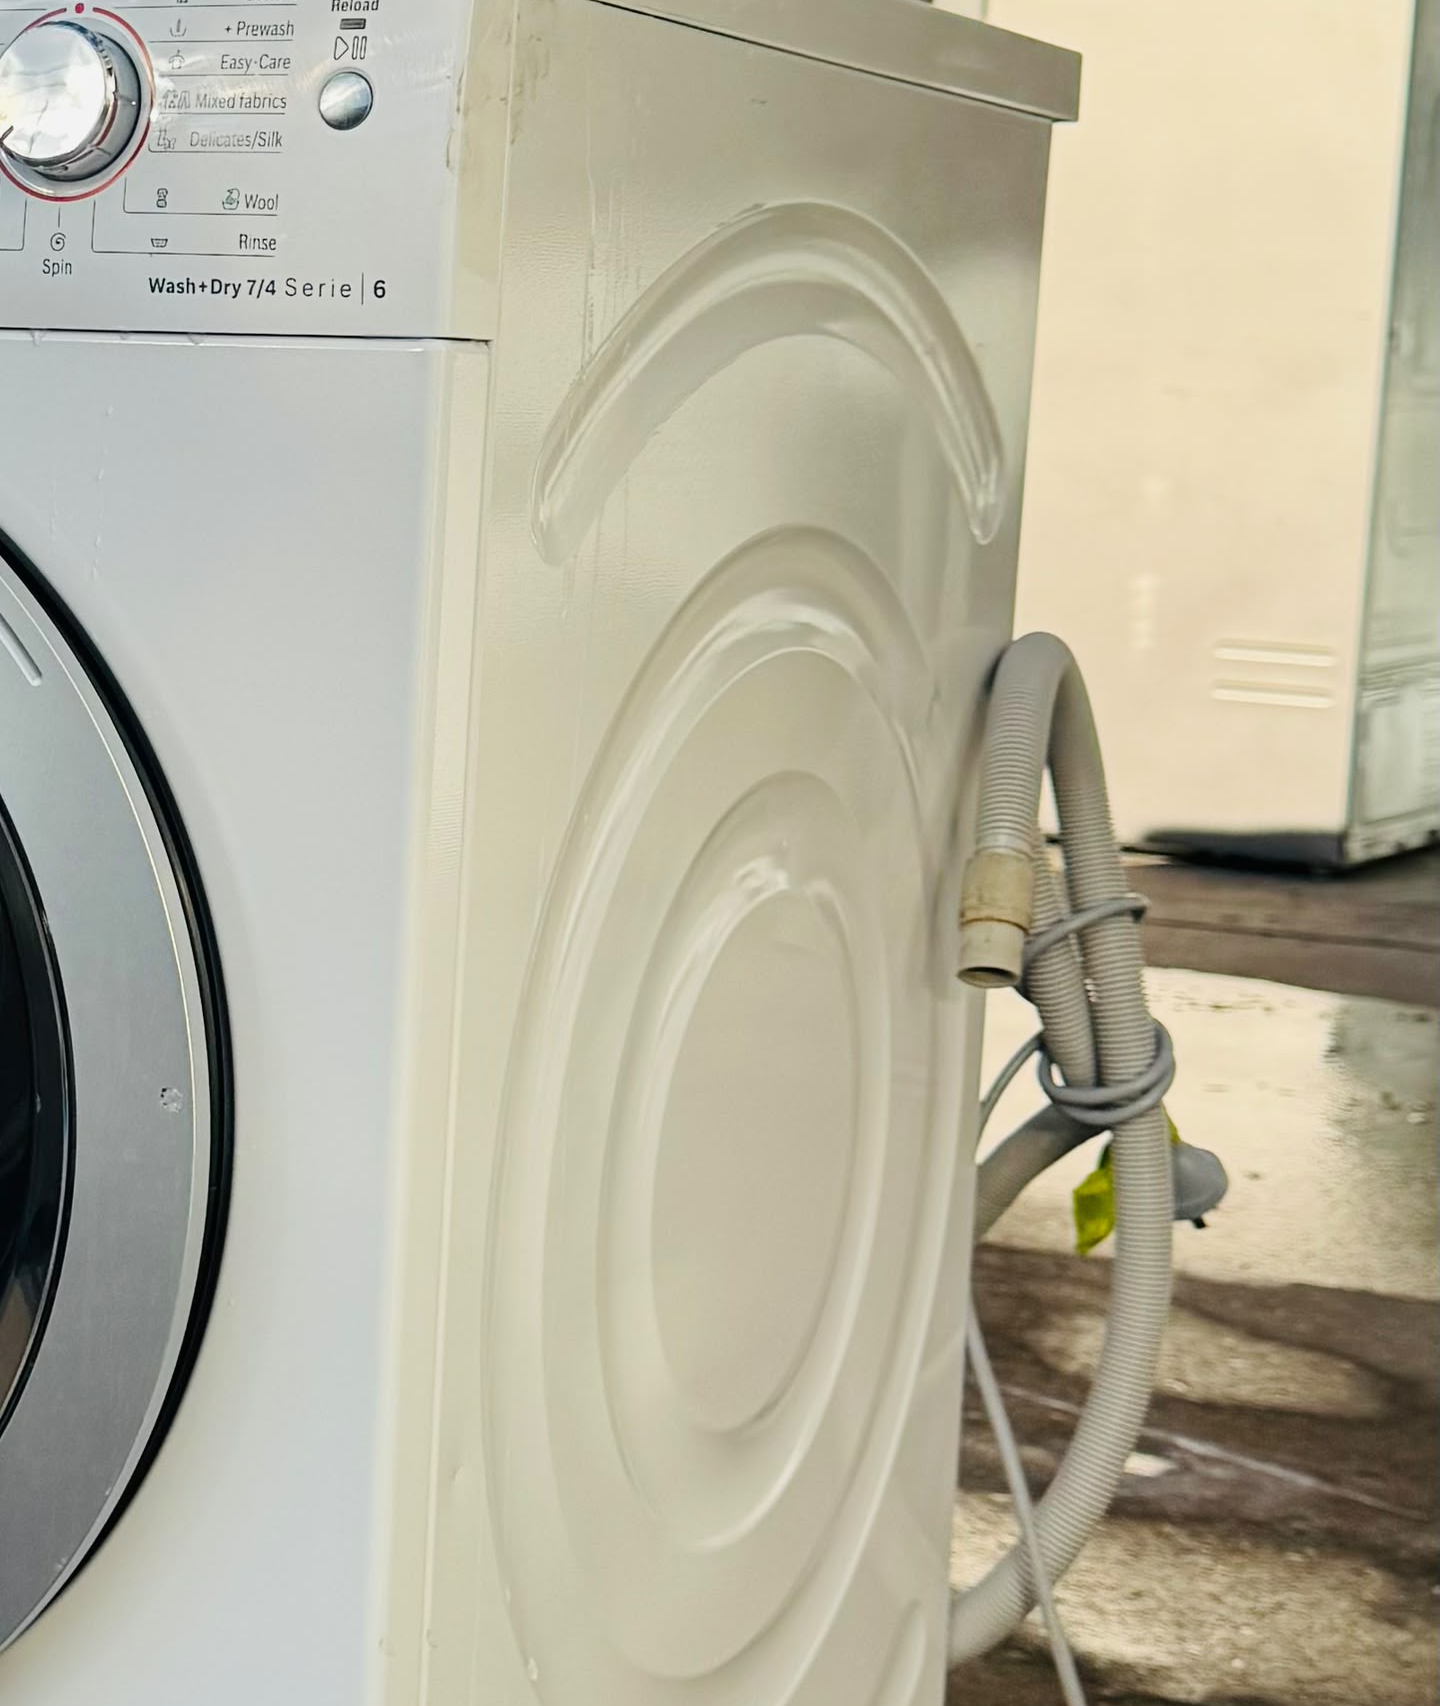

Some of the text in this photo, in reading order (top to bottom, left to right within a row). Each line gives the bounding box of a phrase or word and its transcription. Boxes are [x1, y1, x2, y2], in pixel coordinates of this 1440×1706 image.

[236, 19, 295, 37] Prewash
[195, 92, 288, 110] Mixed fabrics
[190, 131, 283, 150] Delicates/Silk
[244, 193, 279, 211] Wool
[239, 233, 278, 251] Rinse
[42, 258, 73, 278] Spin
[148, 277, 242, 299] Wash+Dry
[246, 279, 277, 299] 7/4
[285, 277, 352, 298] Serie
[373, 279, 387, 299] 6
